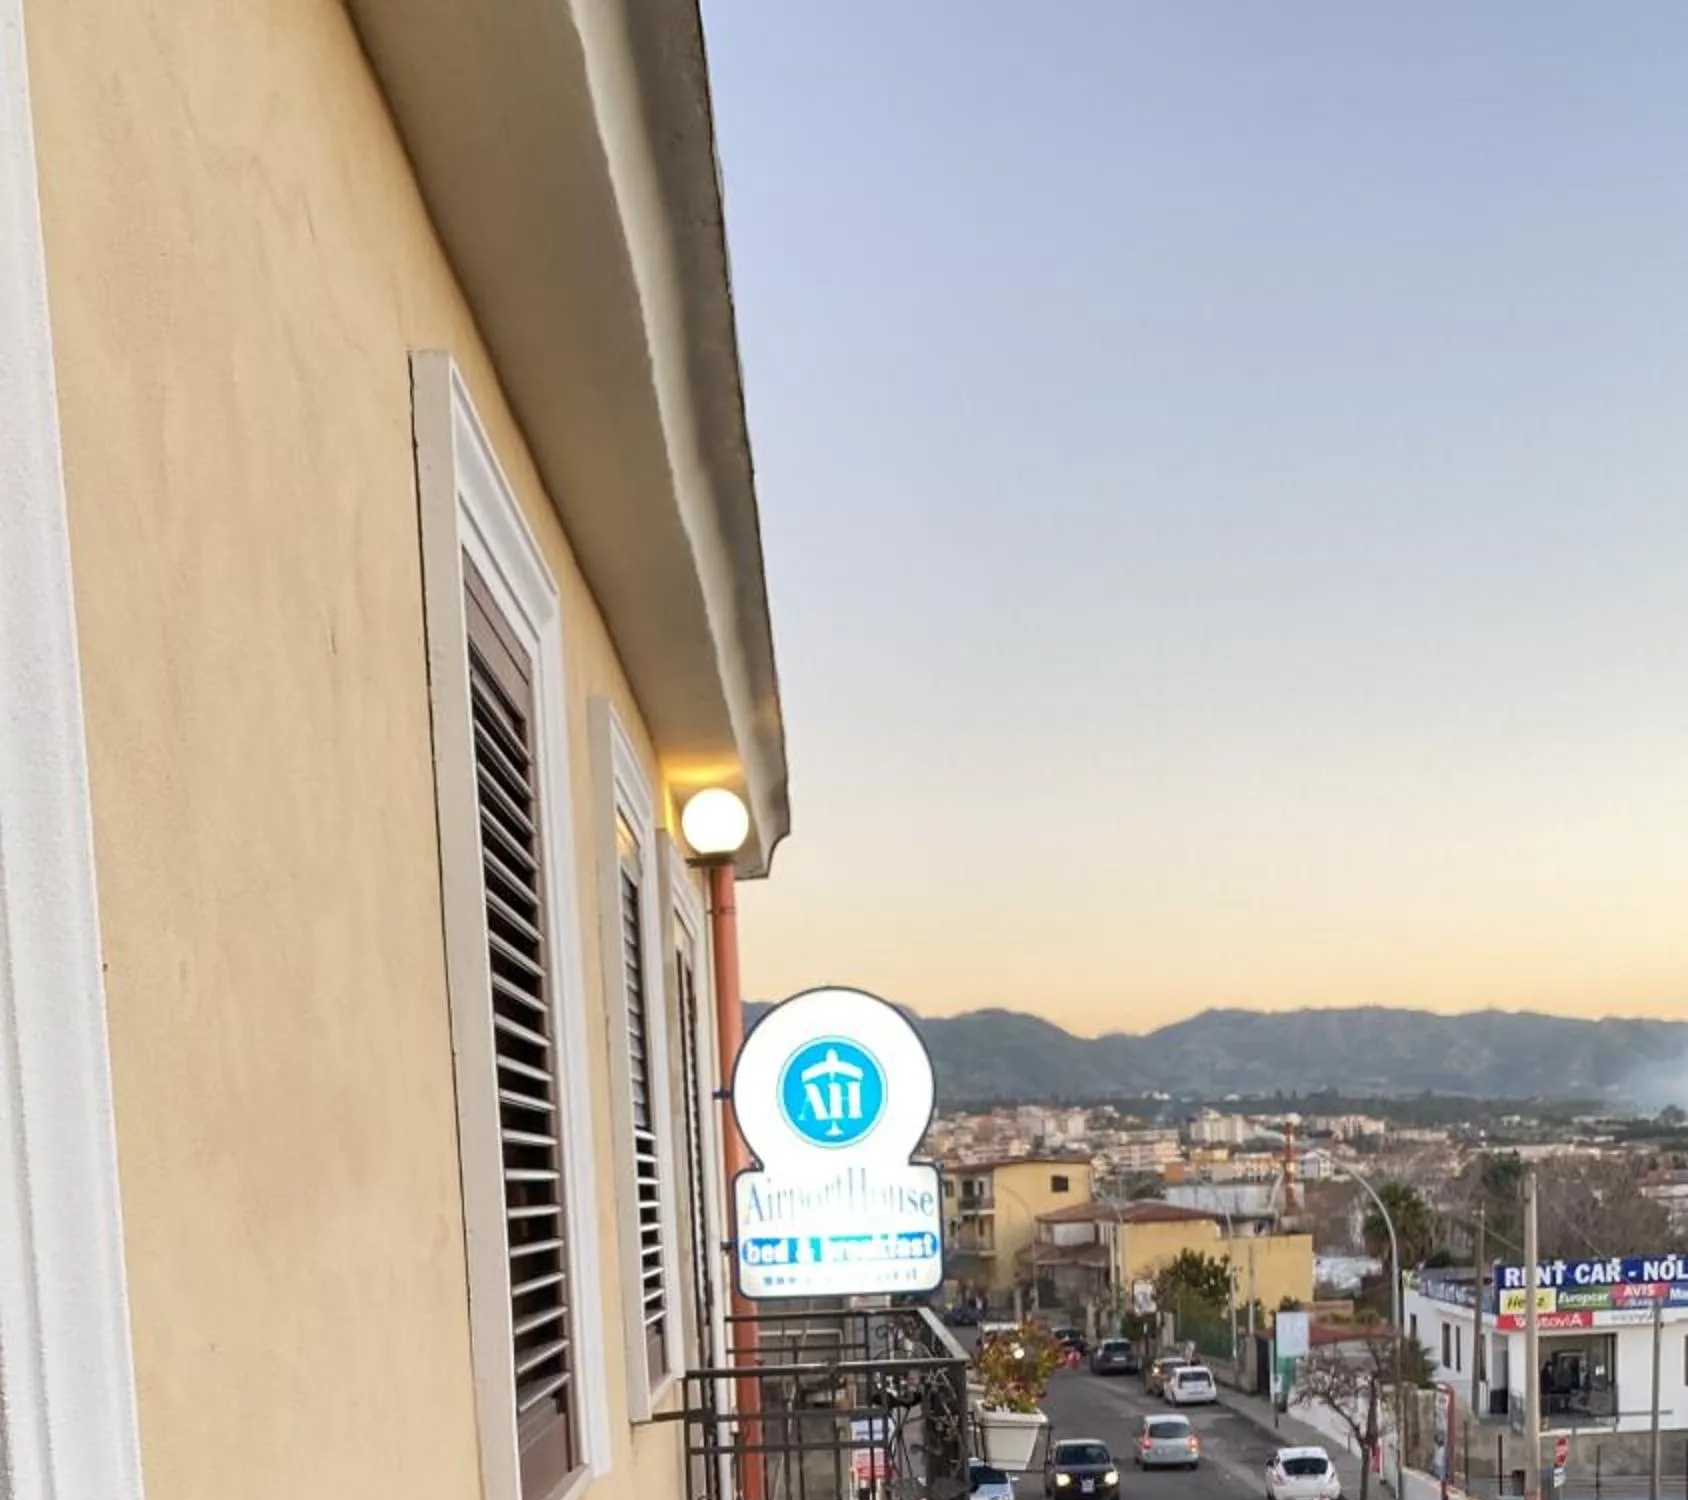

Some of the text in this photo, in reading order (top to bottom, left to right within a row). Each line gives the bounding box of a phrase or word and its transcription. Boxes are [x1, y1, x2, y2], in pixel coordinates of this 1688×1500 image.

[1574, 1262, 1621, 1285] CAR
[1623, 1283, 1655, 1297] AVIS
[1507, 1295, 1546, 1309] Hez
[1558, 1291, 1609, 1307] Europcar
